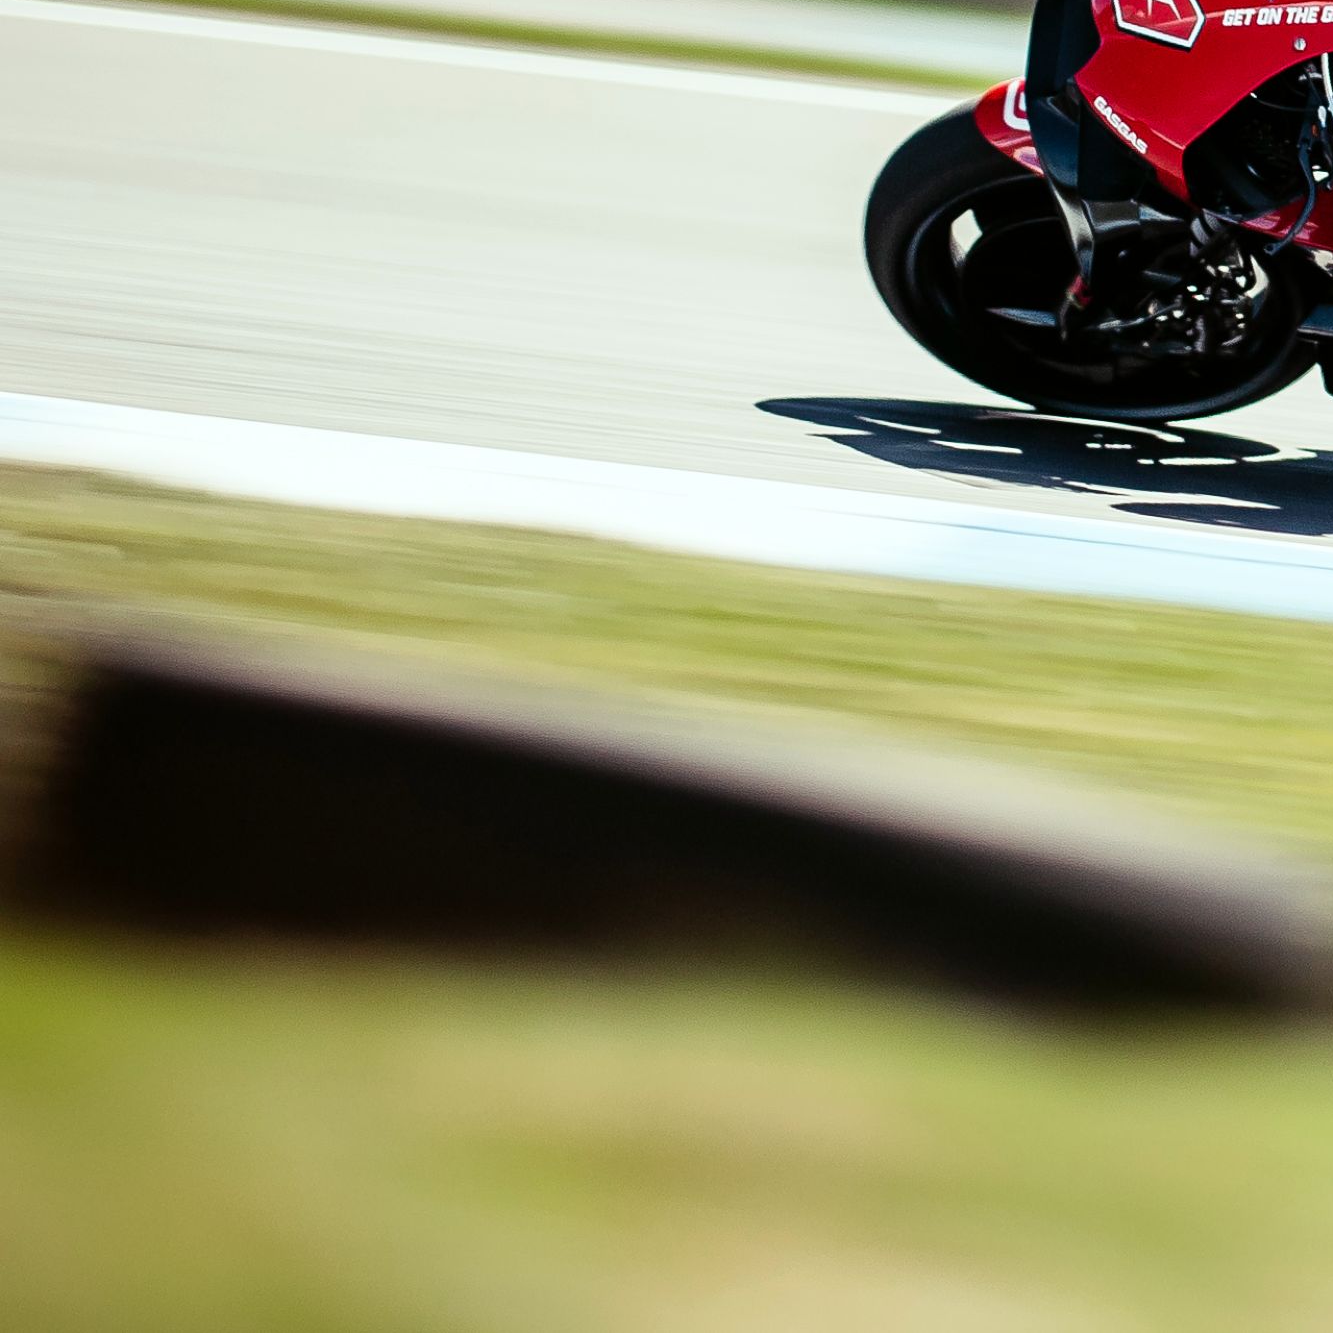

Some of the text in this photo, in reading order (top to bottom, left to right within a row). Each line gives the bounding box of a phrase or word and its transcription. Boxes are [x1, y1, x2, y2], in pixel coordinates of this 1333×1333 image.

[1222, 8, 1252, 27] GET
[1256, 7, 1282, 25] ON
[1284, 6, 1319, 24] THE
[1093, 96, 1149, 155] GASGAS
